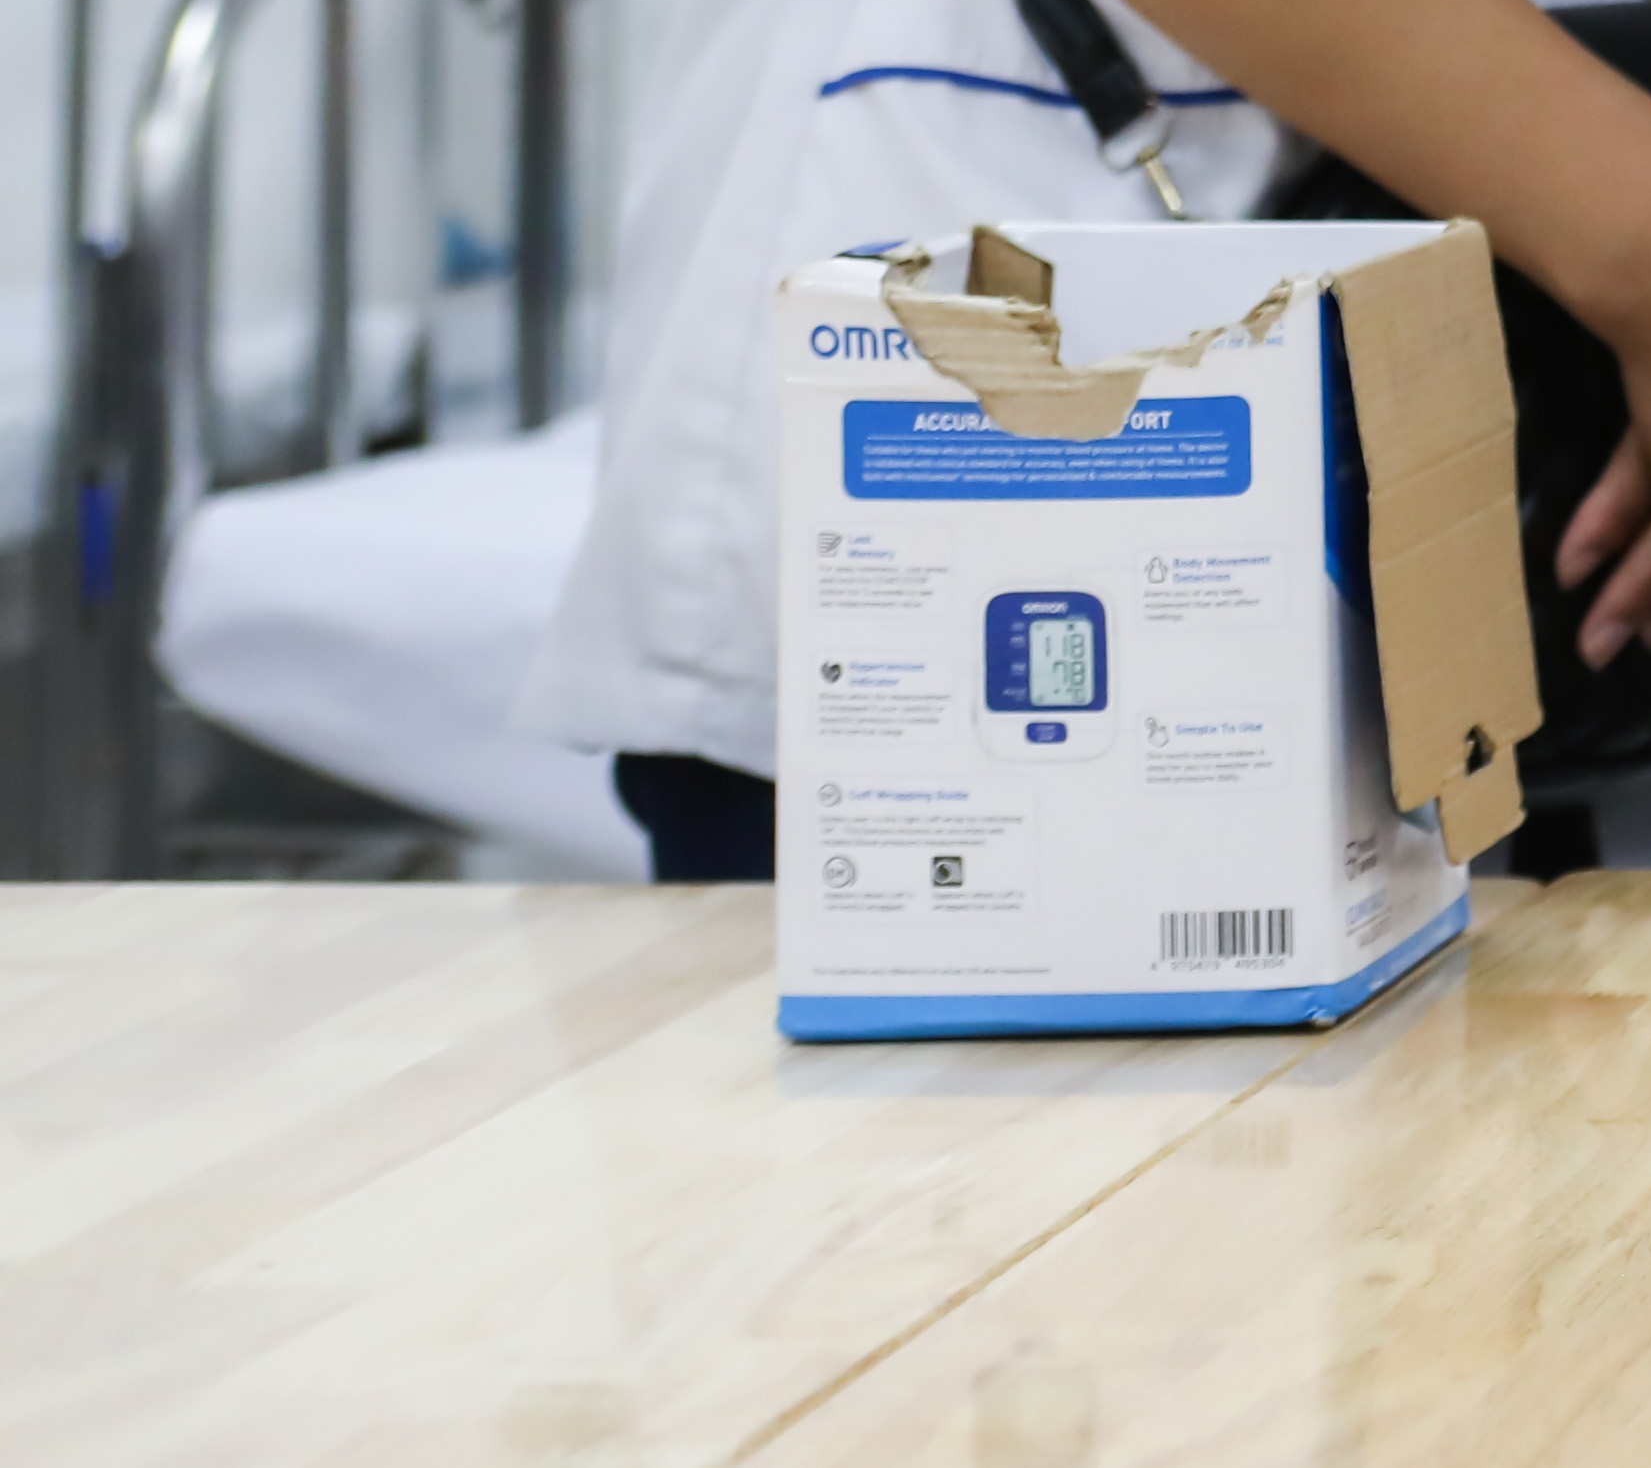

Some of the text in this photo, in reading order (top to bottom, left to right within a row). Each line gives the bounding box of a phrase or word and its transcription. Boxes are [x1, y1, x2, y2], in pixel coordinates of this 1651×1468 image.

[809, 324, 916, 360] OMR
[913, 409, 1174, 432] ACCURA ORT
